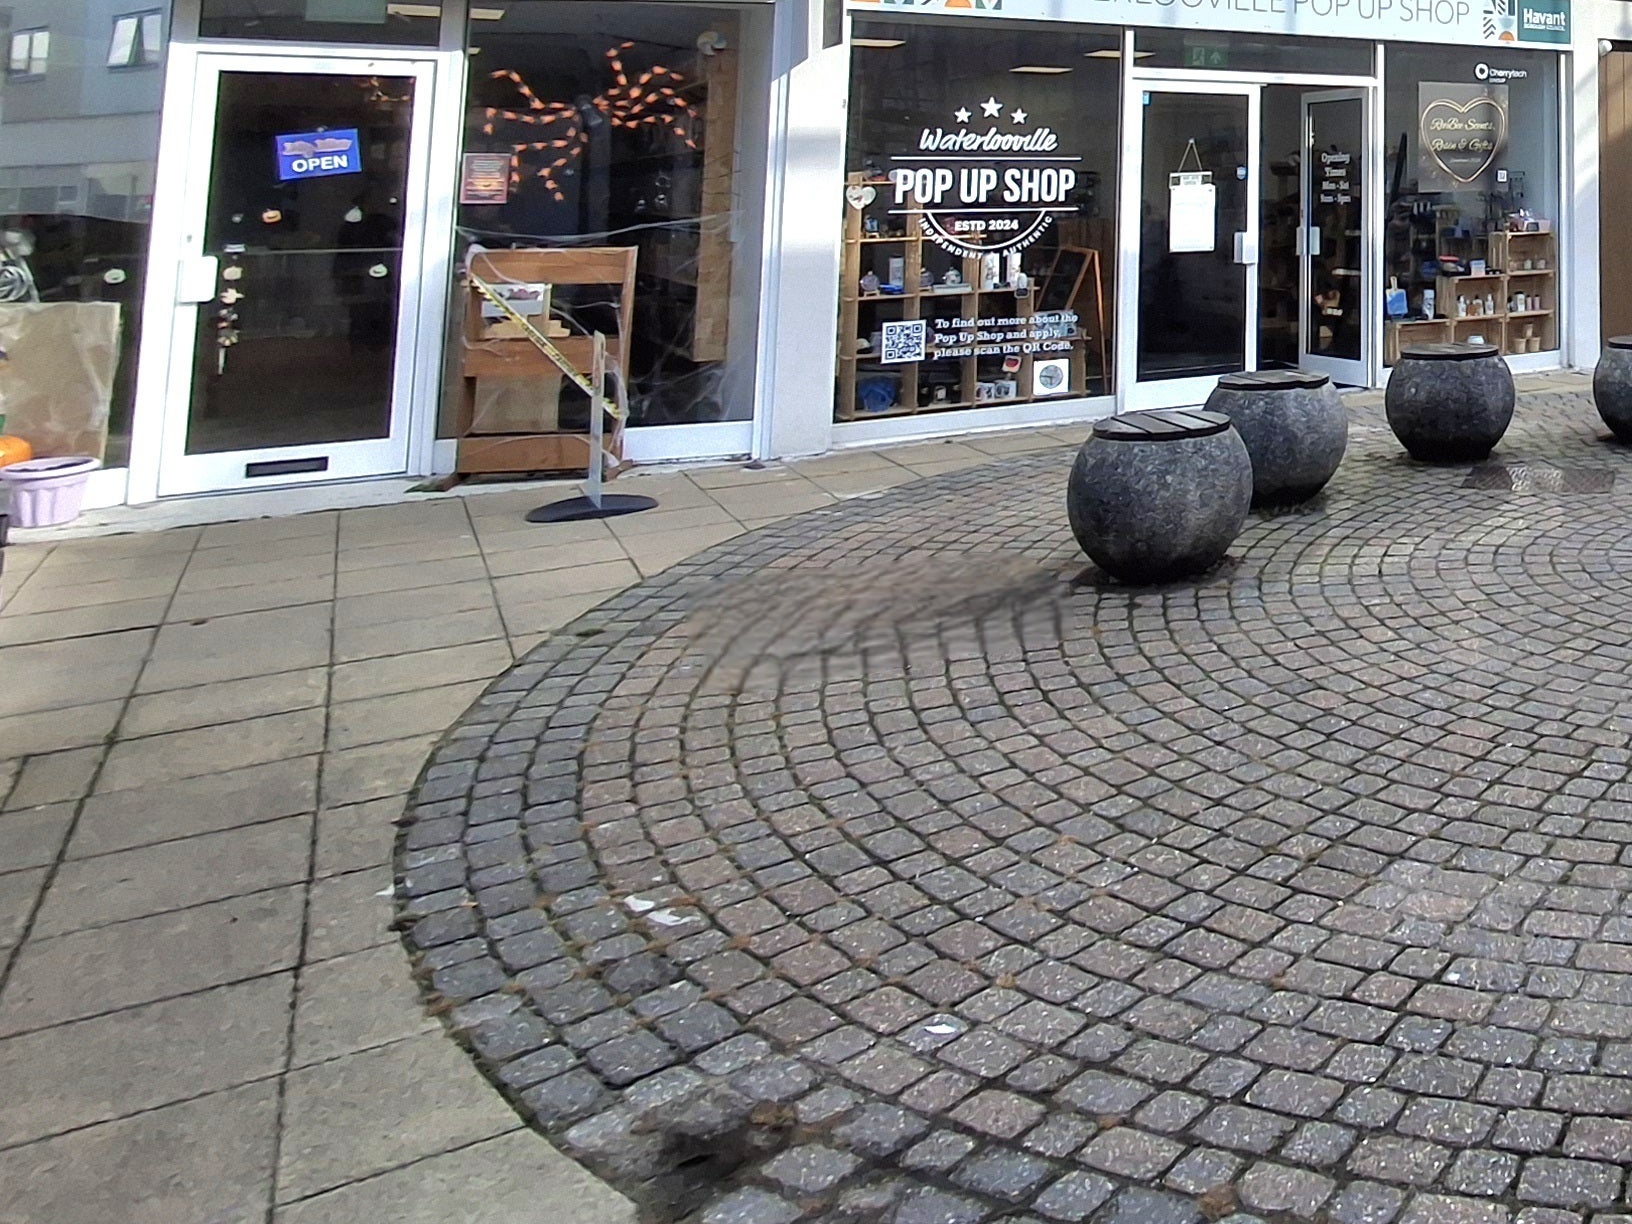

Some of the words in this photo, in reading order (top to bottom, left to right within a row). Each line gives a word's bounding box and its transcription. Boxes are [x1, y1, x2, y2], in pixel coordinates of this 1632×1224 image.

[1523, 8, 1566, 26] Havant
[918, 126, 1059, 152] Waterlooville
[291, 154, 349, 173] OPEN
[894, 168, 953, 204] POP
[959, 168, 998, 204] UP
[1003, 167, 1076, 203] SHOP
[954, 220, 986, 232] ESTD
[988, 219, 1019, 231] 2024
[918, 217, 983, 260] INDEPENDENT
[1002, 215, 1053, 258] AUTHENTIC
[935, 318, 950, 329] To
[951, 318, 975, 328] find
[977, 317, 996, 327] out
[997, 317, 1026, 326] more
[1029, 315, 1059, 325] about
[1060, 314, 1079, 323] the
[934, 334, 957, 345] Pop
[959, 333, 975, 343] Up
[977, 332, 1004, 342] Shop
[1006, 330, 1027, 339] and
[933, 349, 972, 360] please
[974, 347, 1001, 356] scan
[1003, 345, 1020, 354] the
[1022, 344, 1041, 354] QR
